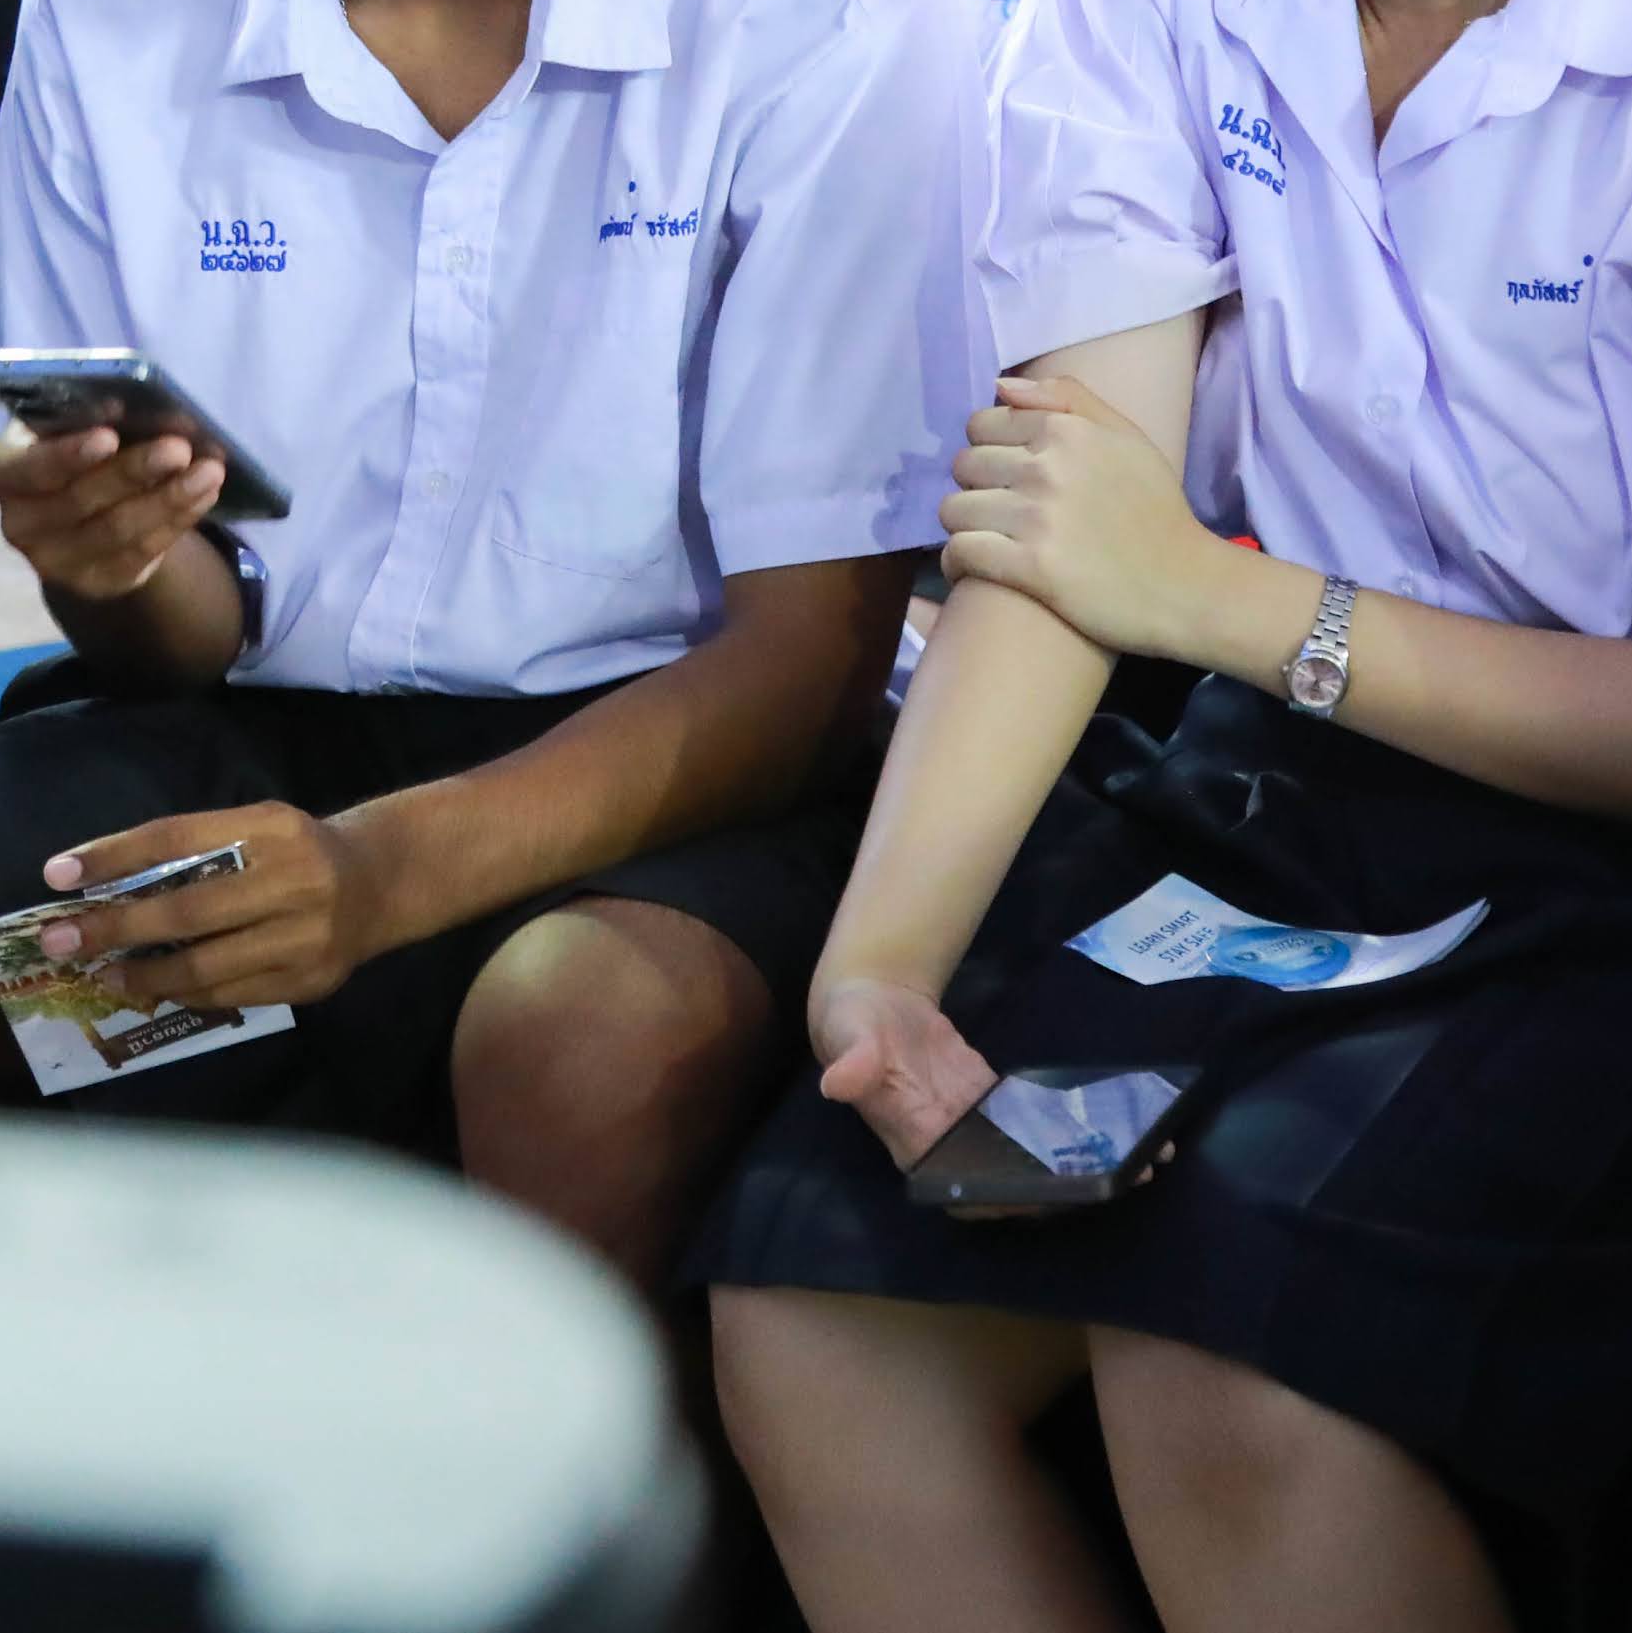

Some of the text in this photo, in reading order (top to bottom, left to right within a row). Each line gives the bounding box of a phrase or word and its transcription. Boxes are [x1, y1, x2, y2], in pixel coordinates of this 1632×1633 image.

[1127, 910, 1200, 955] LEARN SMART
[1158, 941, 1188, 964] STAY
[1183, 926, 1215, 948] SAFE
